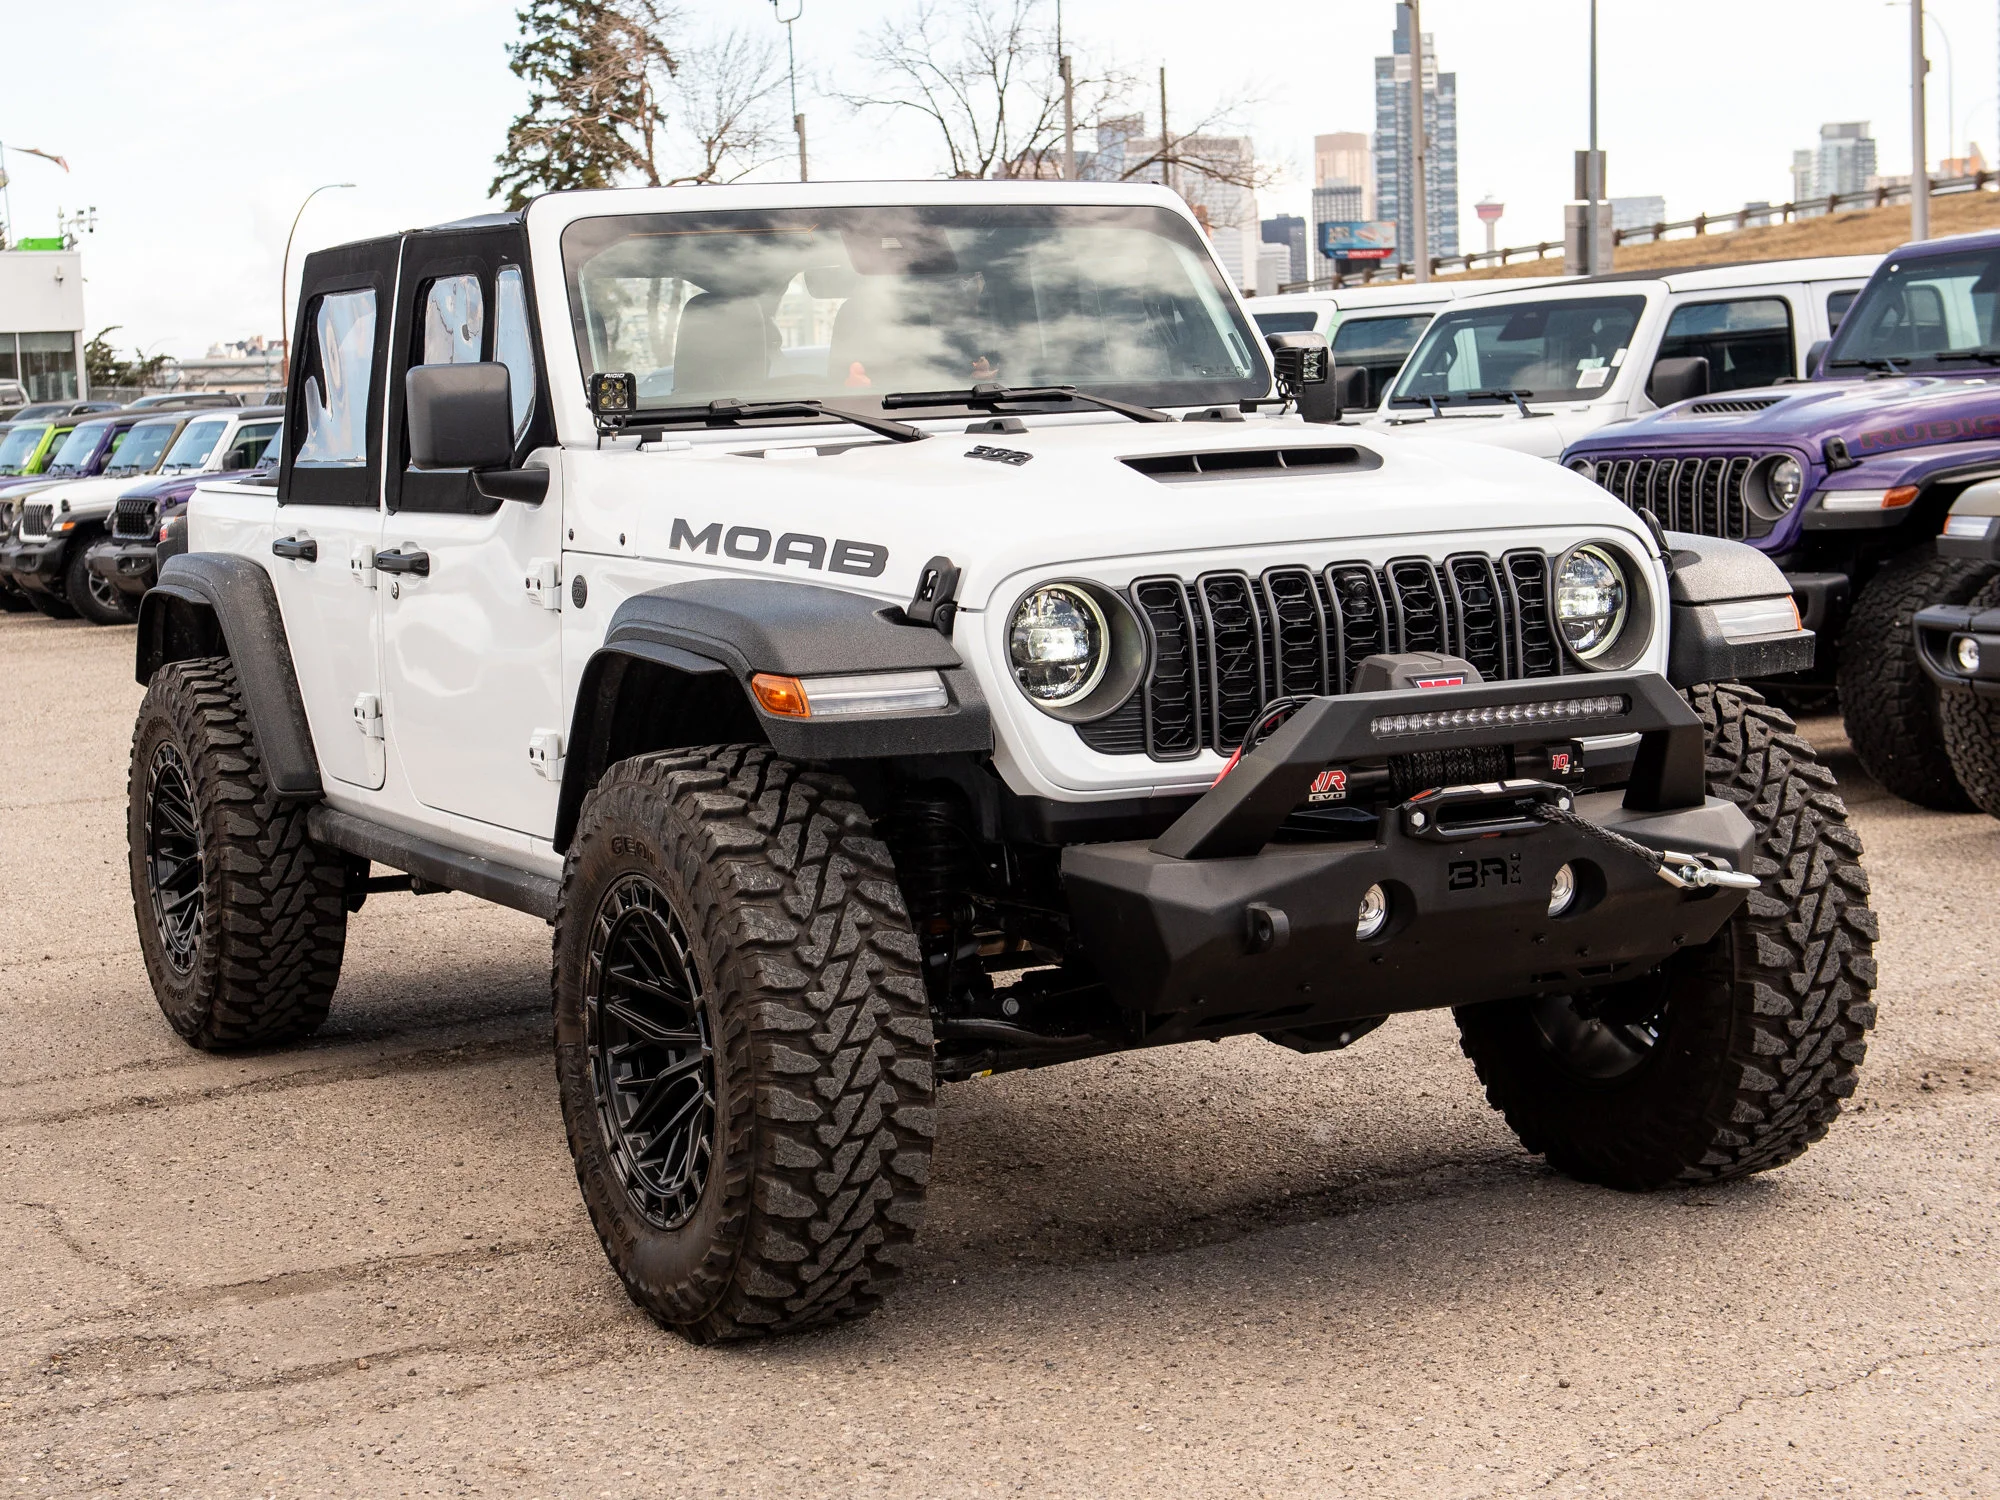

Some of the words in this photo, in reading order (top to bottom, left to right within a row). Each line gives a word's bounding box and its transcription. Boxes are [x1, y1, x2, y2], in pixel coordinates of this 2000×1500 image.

[668, 517, 889, 578] MOAB
[1552, 754, 1568, 770] 10
[1311, 792, 1343, 801] EVO
